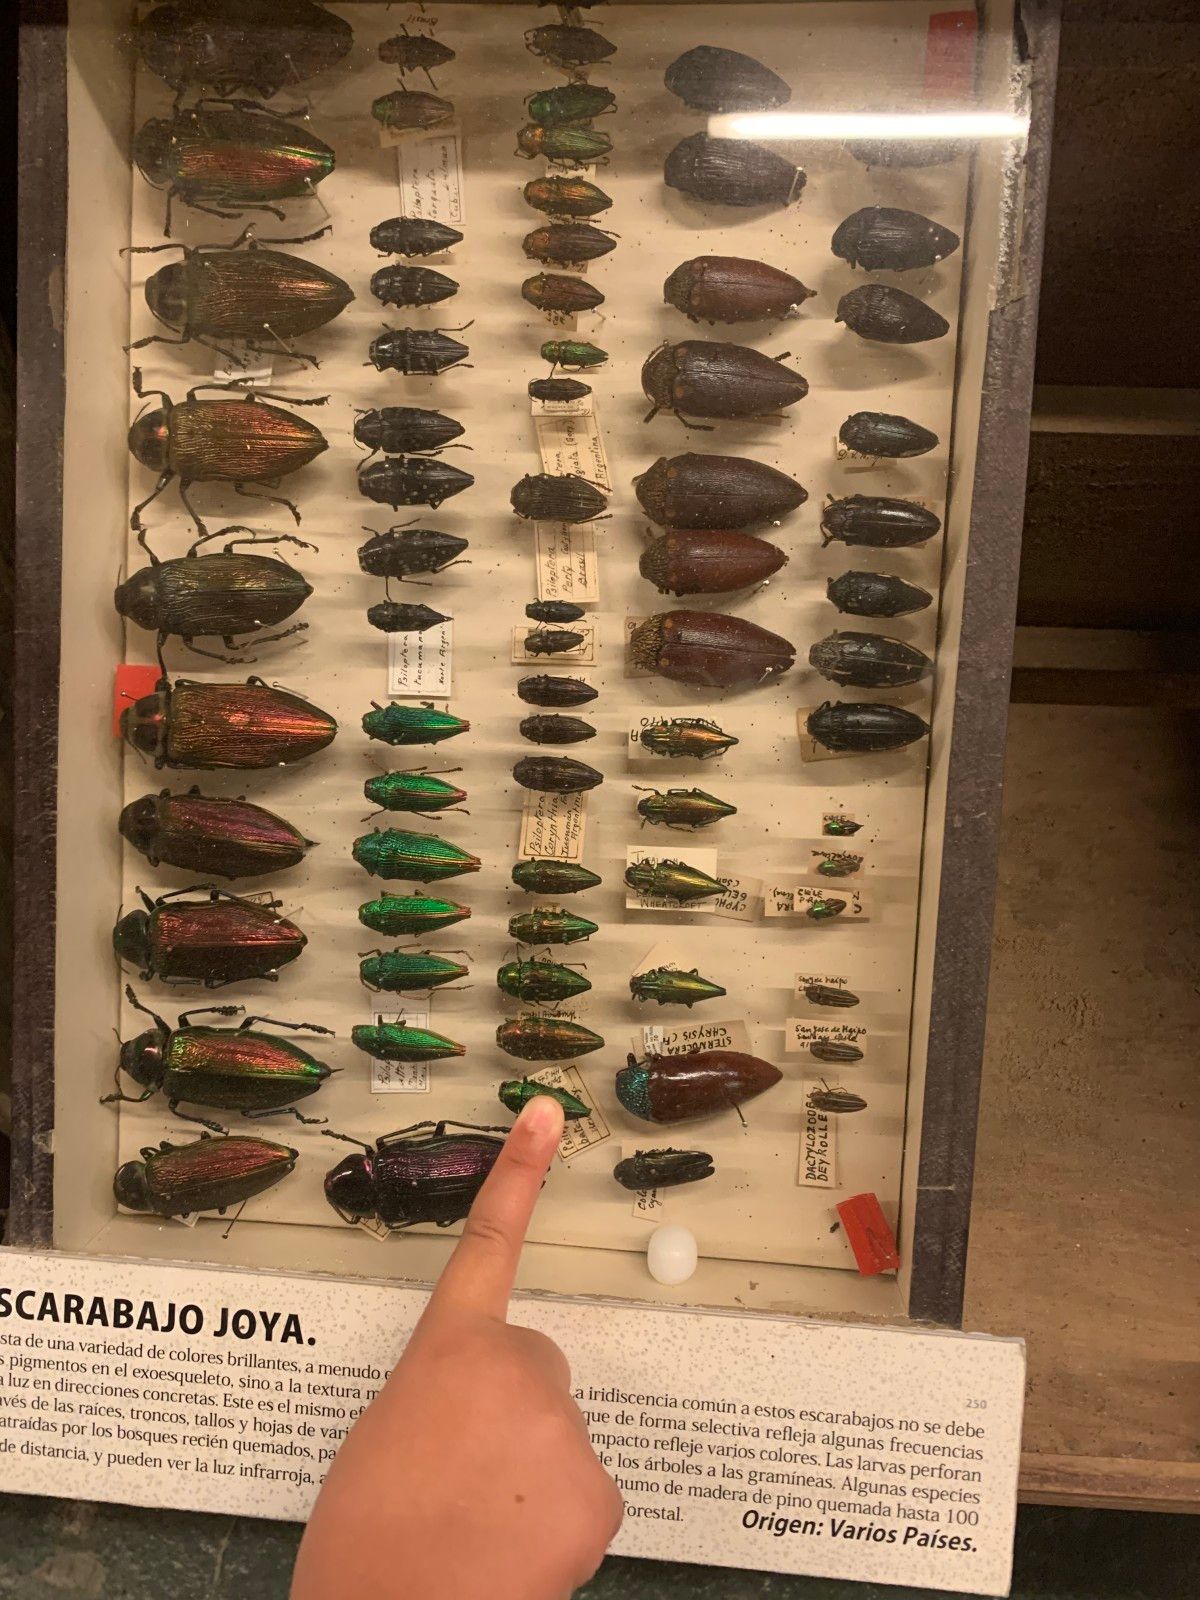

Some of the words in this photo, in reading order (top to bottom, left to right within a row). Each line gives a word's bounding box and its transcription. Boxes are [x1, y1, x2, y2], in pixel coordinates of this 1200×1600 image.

[530, 796, 546, 854] Psiloptera
[682, 1025, 727, 1041] CHRYSIS
[213, 1307, 316, 1346] JOYA.
[10, 1356, 87, 1374] pigmentos
[92, 1364, 109, 1375] en
[114, 1363, 128, 1377] el
[132, 1367, 234, 1388] exoesqueleto,
[239, 1376, 270, 1391] sino
[275, 1381, 283, 1392] a
[289, 1379, 301, 1393] la
[307, 1384, 360, 1399] textura
[25, 1334, 43, 1348] de
[48, 1339, 74, 1351] una
[79, 1341, 143, 1358] variedad
[147, 1345, 165, 1360] de
[169, 1348, 223, 1365] colores
[228, 1352, 301, 1373] brillantes,
[305, 1362, 313, 1373] a
[318, 1365, 381, 1380] menudo
[8, 1373, 30, 1389] luz
[33, 1379, 50, 1390] en
[55, 1378, 139, 1399] direcciones
[143, 1389, 218, 1407] concretas.
[223, 1393, 254, 1409] Este
[257, 1401, 274, 1412] es
[278, 1400, 290, 1413] el
[295, 1403, 345, 1419] mismo
[31, 1396, 49, 1411] de
[54, 1398, 74, 1413] las
[78, 1403, 125, 1419] raíces,
[130, 1408, 190, 1425] troncos,
[195, 1413, 235, 1428] tallos
[239, 1419, 248, 1434] y
[253, 1417, 293, 1437] hojas
[298, 1422, 316, 1437] de
[588, 1386, 678, 1408] iridiscencia
[682, 1399, 736, 1414] común
[741, 1404, 749, 1415] a
[754, 1406, 795, 1419] estos
[800, 1409, 894, 1431] escarabajos
[899, 1420, 919, 1431] no
[923, 1422, 941, 1434] se
[945, 1421, 985, 1438] debe
[966, 1398, 987, 1409] 250
[62, 1424, 87, 1437] por
[92, 1422, 112, 1438] los
[117, 1425, 178, 1446] bosques
[182, 1434, 228, 1449] recién
[233, 1439, 314, 1460] quemados,
[615, 1411, 634, 1425] de
[640, 1412, 686, 1430] forma
[691, 1419, 760, 1438] selectiva
[766, 1426, 816, 1446] refleja
[822, 1431, 884, 1451] algunas
[890, 1437, 984, 1460] frecuencias
[21, 1441, 89, 1461] distancia,
[93, 1452, 102, 1466] y
[107, 1453, 162, 1468] pueden
[168, 1459, 191, 1471] ver
[196, 1458, 208, 1473] la
[213, 1459, 235, 1476] luz
[240, 1463, 314, 1486] infrarroja,
[618, 1453, 639, 1469] los
[644, 1456, 702, 1476] árboles
[707, 1466, 716, 1477] a
[722, 1464, 743, 1480] las
[748, 1471, 836, 1490] gramíneas.
[841, 1476, 907, 1497] Algunas
[912, 1487, 981, 1504] especies
[654, 1437, 703, 1458] refleje
[708, 1444, 755, 1459] varios
[760, 1448, 821, 1466] colores.
[826, 1452, 853, 1470] Las
[858, 1455, 906, 1475] larvas
[911, 1465, 982, 1482] perforan
[614, 1475, 660, 1493] humo
[664, 1481, 683, 1495] de
[688, 1486, 747, 1502] madera
[752, 1489, 772, 1504] de
[777, 1493, 812, 1510] pino
[816, 1500, 892, 1517] quemada
[897, 1504, 940, 1522] hasta
[948, 1510, 979, 1526] 100
[742, 1509, 824, 1537] Origen:
[831, 1518, 898, 1544] Varios
[902, 1526, 977, 1552] Países.
